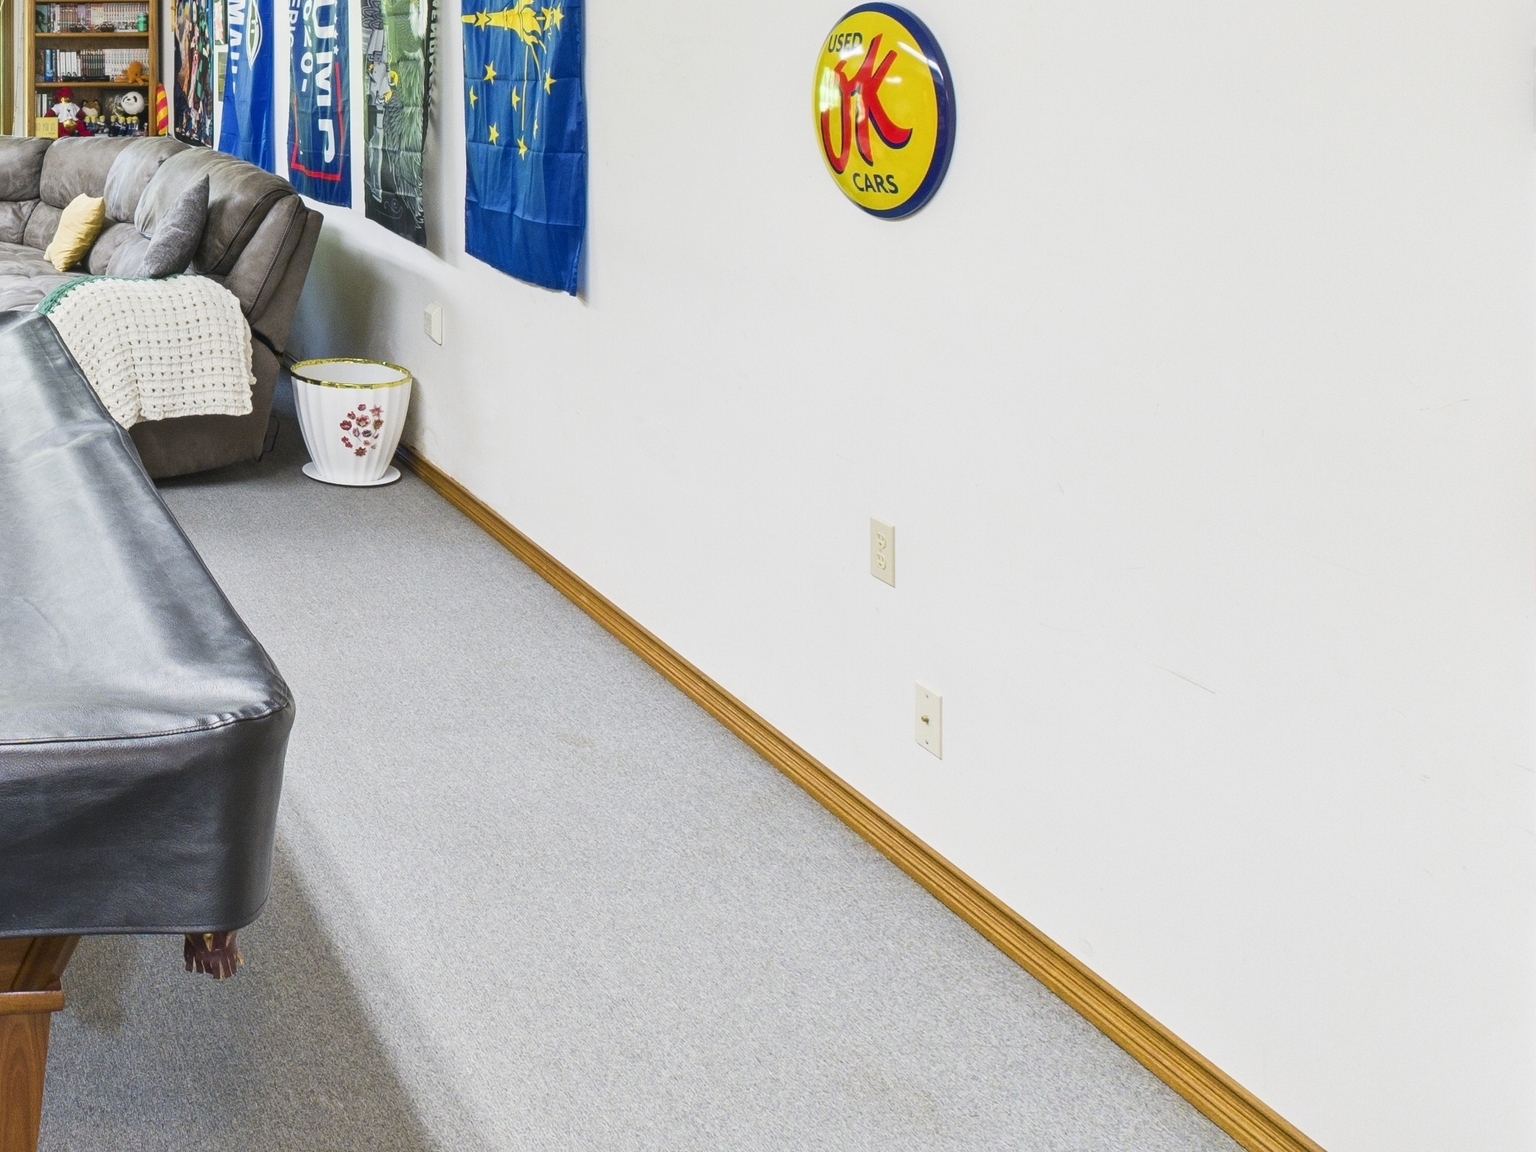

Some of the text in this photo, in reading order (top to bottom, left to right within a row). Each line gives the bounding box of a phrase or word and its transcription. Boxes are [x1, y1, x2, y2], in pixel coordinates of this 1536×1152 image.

[828, 33, 863, 54] USED
[821, 33, 913, 175] OK
[852, 172, 899, 195] CARS
